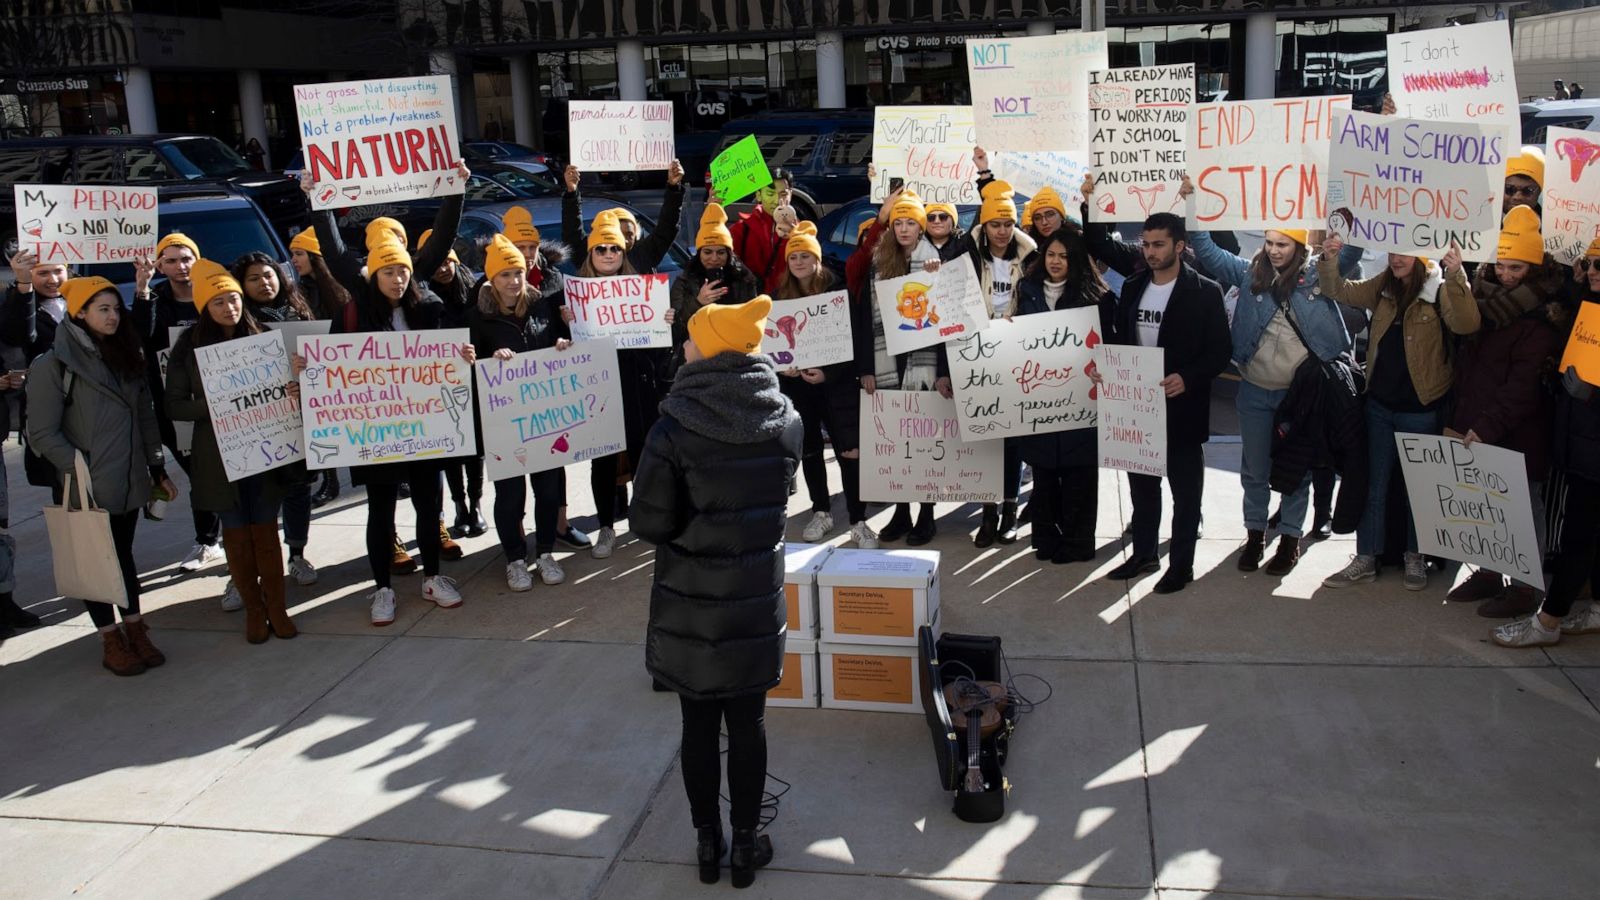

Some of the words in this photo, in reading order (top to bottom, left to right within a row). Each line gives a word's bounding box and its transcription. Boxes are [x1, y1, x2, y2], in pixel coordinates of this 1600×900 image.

[878, 36, 910, 49] CVS
[916, 36, 940, 46] Photo
[1401, 41, 1412, 63] I
[1421, 37, 1460, 60] don't
[973, 43, 1011, 66] NOT
[663, 62, 680, 72] citi
[1090, 71, 1100, 84] I
[1104, 67, 1168, 84] ALREADY
[1169, 66, 1194, 80] HAVE
[296, 87, 321, 101] Not
[363, 83, 383, 95] Not
[387, 80, 439, 96] disgusting.
[1135, 87, 1192, 104] PERIODS
[300, 104, 323, 118] Not
[331, 100, 384, 114] shameful.
[388, 97, 410, 111] Not
[571, 104, 638, 122] menstrual
[697, 103, 726, 115] CVS
[994, 96, 1032, 114] NOT
[1092, 108, 1111, 123] TO
[1117, 108, 1164, 123] WORRY
[1163, 110, 1186, 123] ABO
[1406, 103, 1414, 119] I
[1424, 102, 1449, 119] still
[1466, 102, 1504, 118] care
[303, 120, 328, 137] Not
[335, 121, 343, 131] a
[619, 125, 627, 135] IS
[880, 113, 951, 144] What
[1092, 129, 1117, 143] AT
[1122, 128, 1182, 143] SCHOOL
[1197, 104, 1256, 150] END
[581, 139, 621, 162] GENDER
[1340, 114, 1389, 155] ARM
[1403, 123, 1502, 165] SCHOOLS
[307, 125, 461, 183] NATURAL
[1093, 152, 1105, 167] I
[1111, 149, 1151, 164] DON'T
[1095, 169, 1167, 185] ANOTHER
[1375, 163, 1423, 184] WITH
[24, 190, 57, 218] My
[73, 188, 157, 211] PERIOD
[1196, 163, 1328, 222] STIGM
[1343, 170, 1470, 221] TAMPONS
[1546, 188, 1600, 214] SOMETHIN
[57, 222, 77, 235] IS
[83, 218, 109, 234] NOT
[114, 217, 153, 236] YOUR
[1353, 217, 1405, 245] NOT
[1412, 223, 1481, 251] GUNS
[1554, 217, 1584, 236] NOT
[27, 241, 84, 263] TAX
[96, 241, 155, 261] REVENUE
[566, 278, 641, 304] STUDENTS
[830, 296, 845, 306] TAX
[597, 303, 655, 326] BLEED
[807, 304, 828, 317] WE
[1137, 309, 1162, 323] ERIO
[303, 338, 355, 364] NOT
[357, 335, 401, 361] ALL
[402, 334, 464, 360] WOMEN
[956, 331, 1002, 361] Go
[1018, 326, 1084, 351] with
[206, 357, 290, 395] CONDOMS
[326, 362, 462, 389] Menstruate,
[480, 359, 538, 388] Would
[543, 357, 567, 376] you
[571, 353, 593, 364] use
[960, 367, 1003, 389] the
[1012, 360, 1077, 393] flow
[1117, 368, 1132, 381] NOT
[308, 390, 345, 409] and
[348, 387, 378, 405] not
[378, 385, 402, 402] all
[487, 394, 514, 412] this
[519, 373, 584, 405] POSTER
[586, 375, 599, 385] as
[601, 370, 610, 381] a
[872, 392, 884, 412] IN
[315, 398, 446, 425] menstruators
[511, 393, 597, 443] TAMPON?
[961, 397, 1005, 419] End
[1014, 391, 1077, 423] period
[900, 418, 938, 439] PERIOD
[1032, 408, 1098, 432] poverty
[311, 427, 342, 440] are
[344, 419, 428, 446] Women
[1112, 428, 1144, 446] HUMAN
[260, 440, 300, 467] Sex
[904, 441, 913, 459] 1
[932, 441, 945, 461] 5
[1402, 438, 1447, 465] End
[879, 466, 892, 475] out
[902, 465, 912, 475] of
[958, 469, 983, 483] during
[1436, 484, 1509, 543] Poverty
[1436, 524, 1454, 549] in
[1458, 526, 1531, 575] schools
